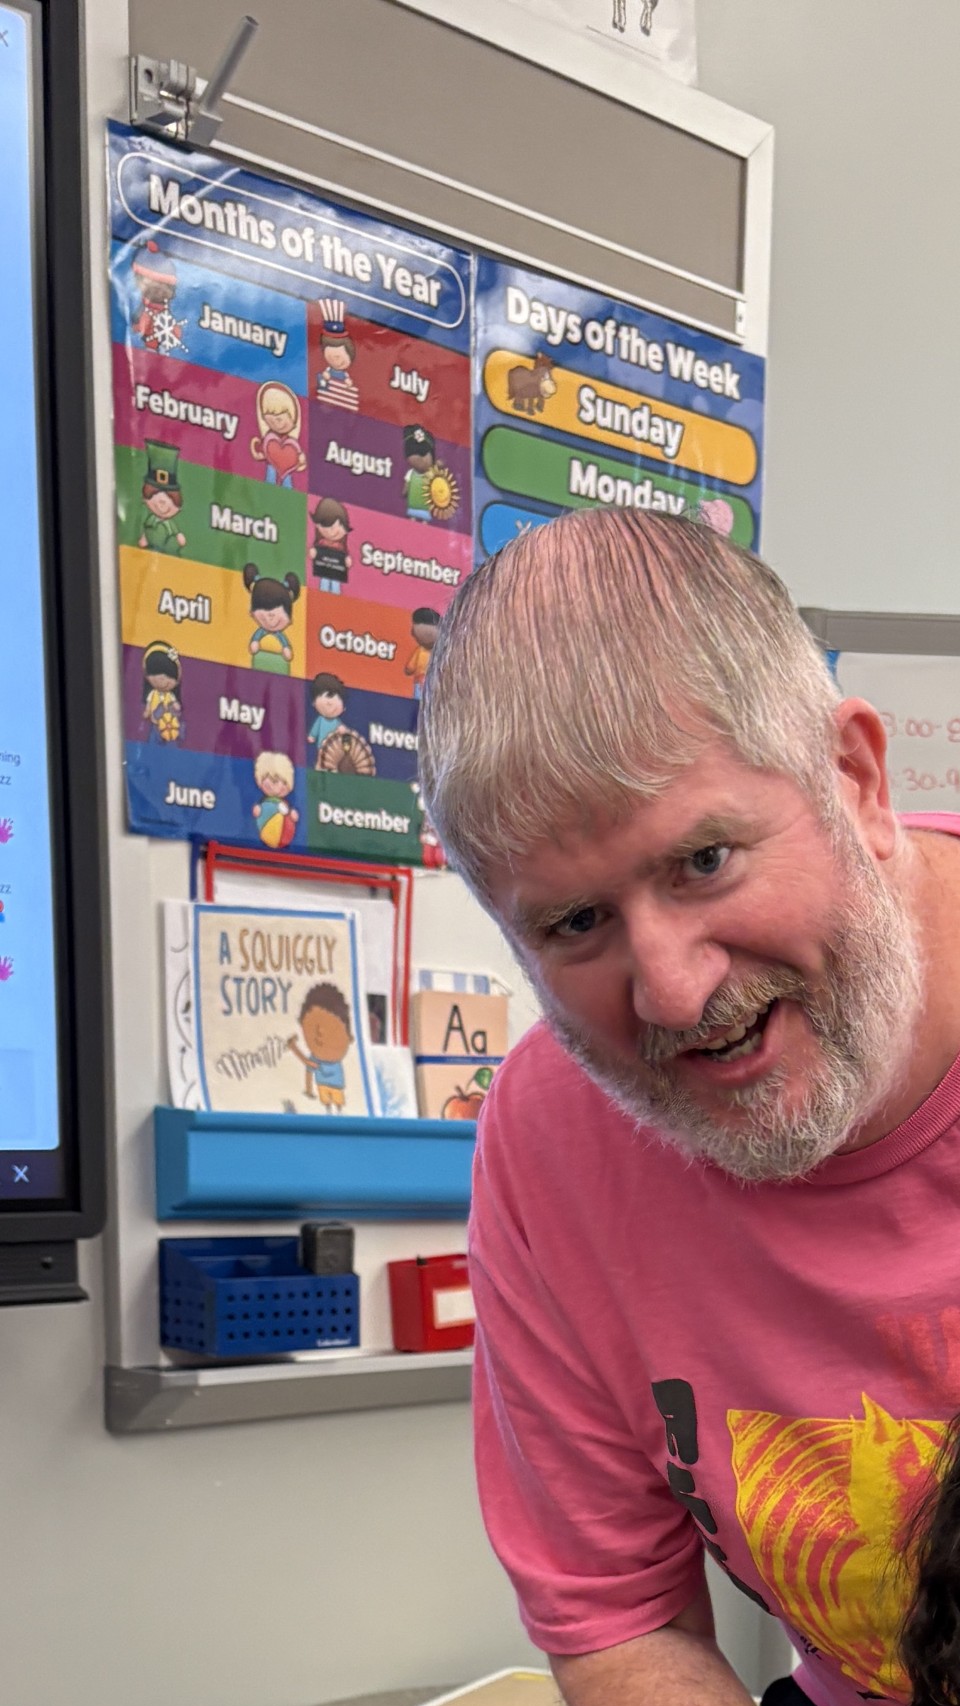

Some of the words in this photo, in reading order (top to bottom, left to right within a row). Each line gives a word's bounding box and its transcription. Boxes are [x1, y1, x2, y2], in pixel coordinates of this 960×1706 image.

[149, 175, 277, 250] Months
[281, 227, 315, 262] of
[320, 233, 373, 283] the
[375, 252, 442, 307] Year
[199, 303, 288, 358] January
[506, 286, 582, 346] Days
[584, 317, 617, 355] of
[617, 326, 664, 373] the
[666, 342, 741, 400] Week
[390, 366, 431, 402] July
[135, 383, 239, 440] February
[577, 385, 685, 459] Sunday
[326, 441, 393, 478] August
[569, 458, 686, 515] Monday
[211, 504, 279, 543] March
[361, 543, 461, 586] September
[158, 588, 212, 624] April
[319, 625, 397, 661] October
[219, 697, 265, 730] May
[165, 781, 217, 809] June
[318, 803, 410, 834] December
[218, 930, 231, 965] A
[238, 928, 338, 976] SQUIGGLY
[220, 974, 293, 1016] STORY
[442, 1004, 488, 1055] Aa
